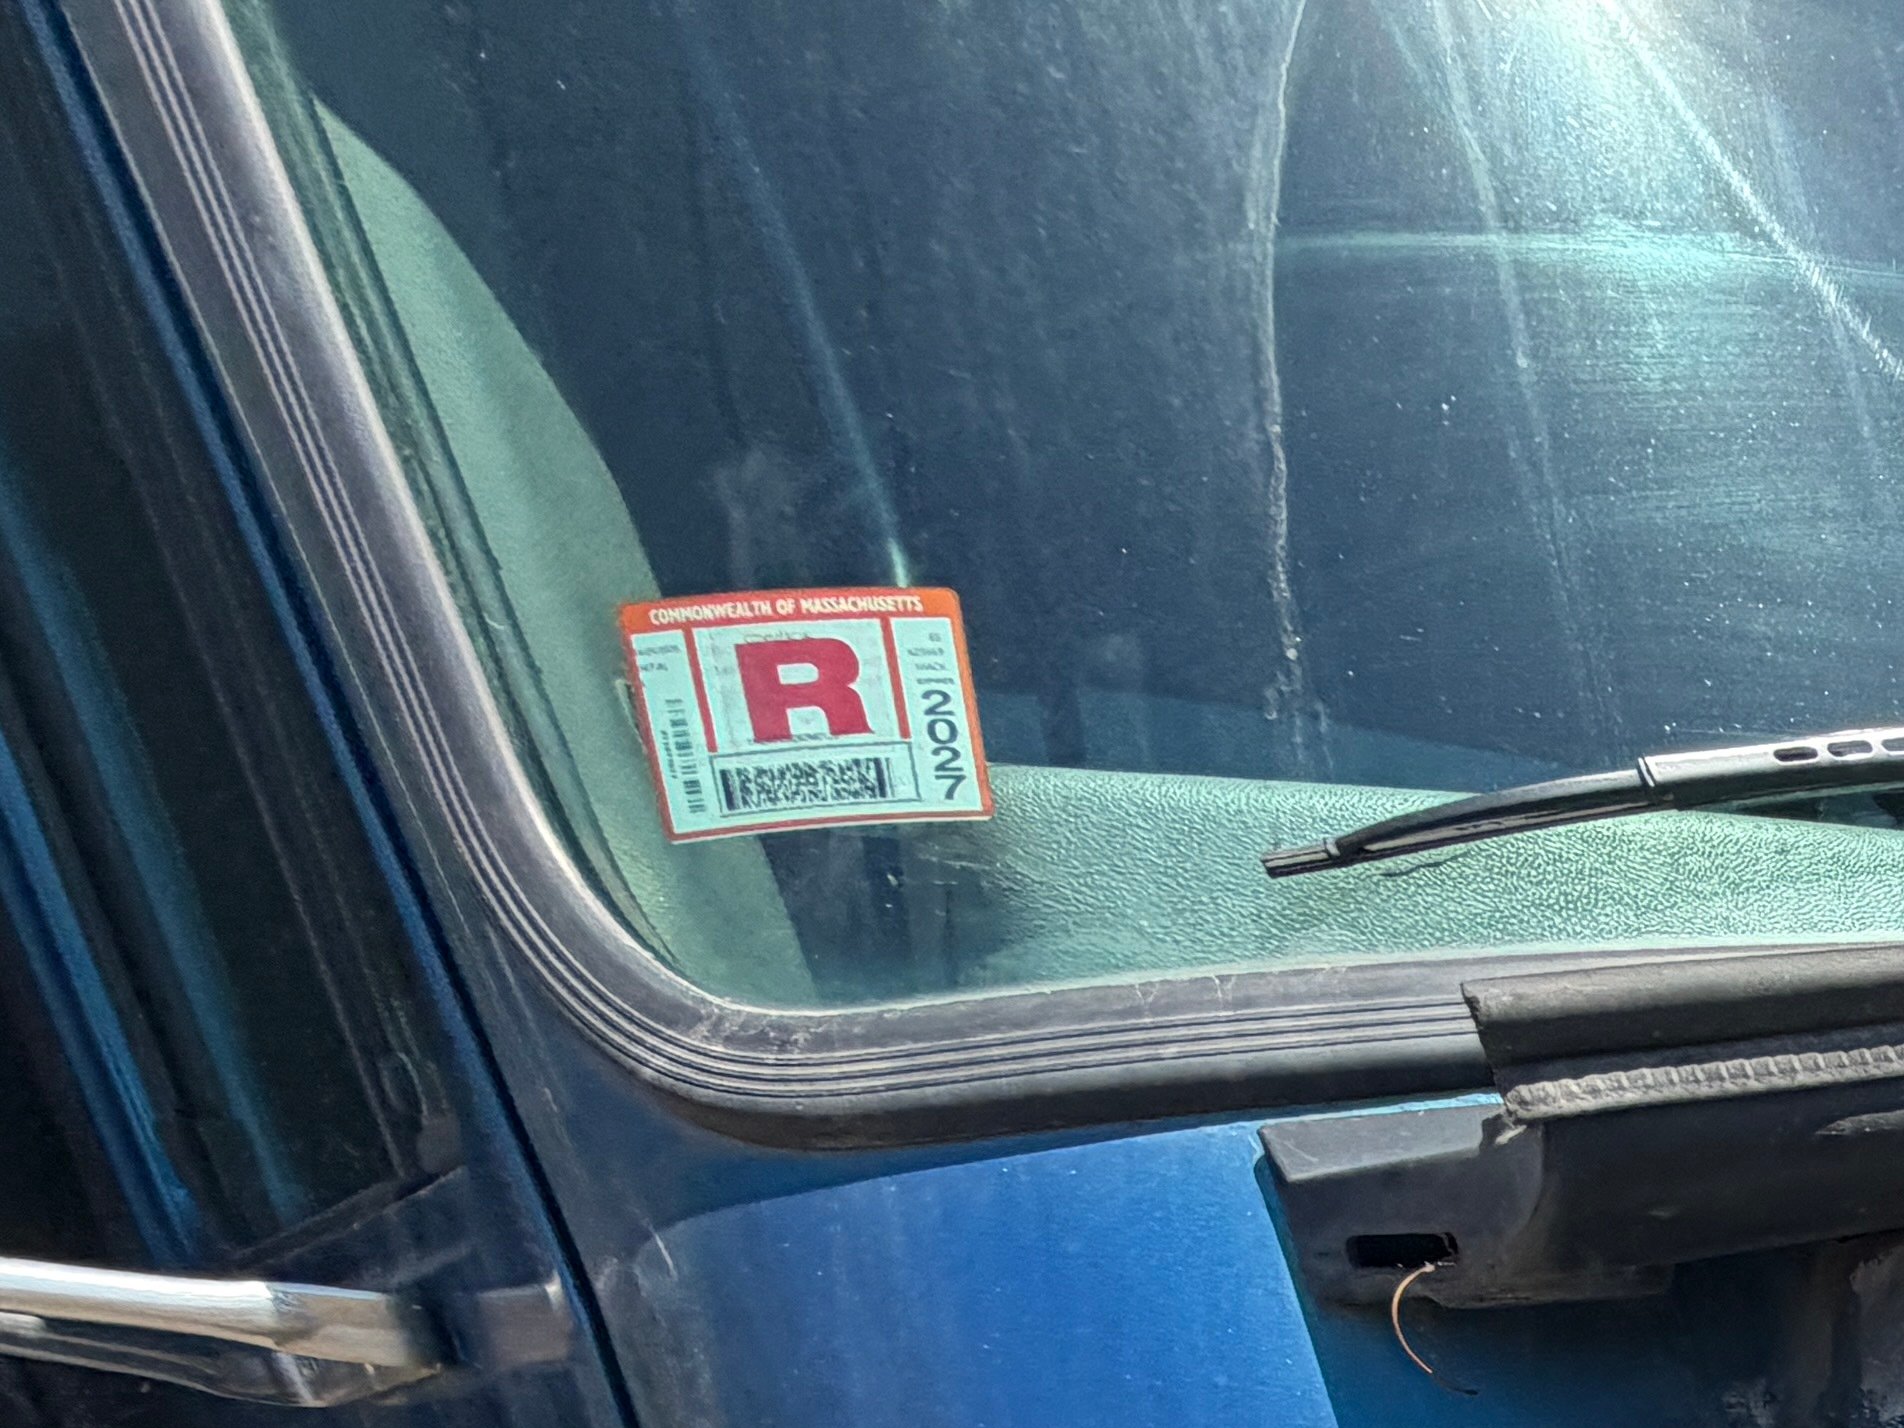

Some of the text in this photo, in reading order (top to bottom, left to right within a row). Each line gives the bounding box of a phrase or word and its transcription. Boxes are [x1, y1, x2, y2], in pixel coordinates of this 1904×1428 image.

[648, 595, 924, 625] COMMONWEALTH OF MASSACHUSETTS
[734, 637, 876, 743] R
[921, 689, 967, 801] 2027
